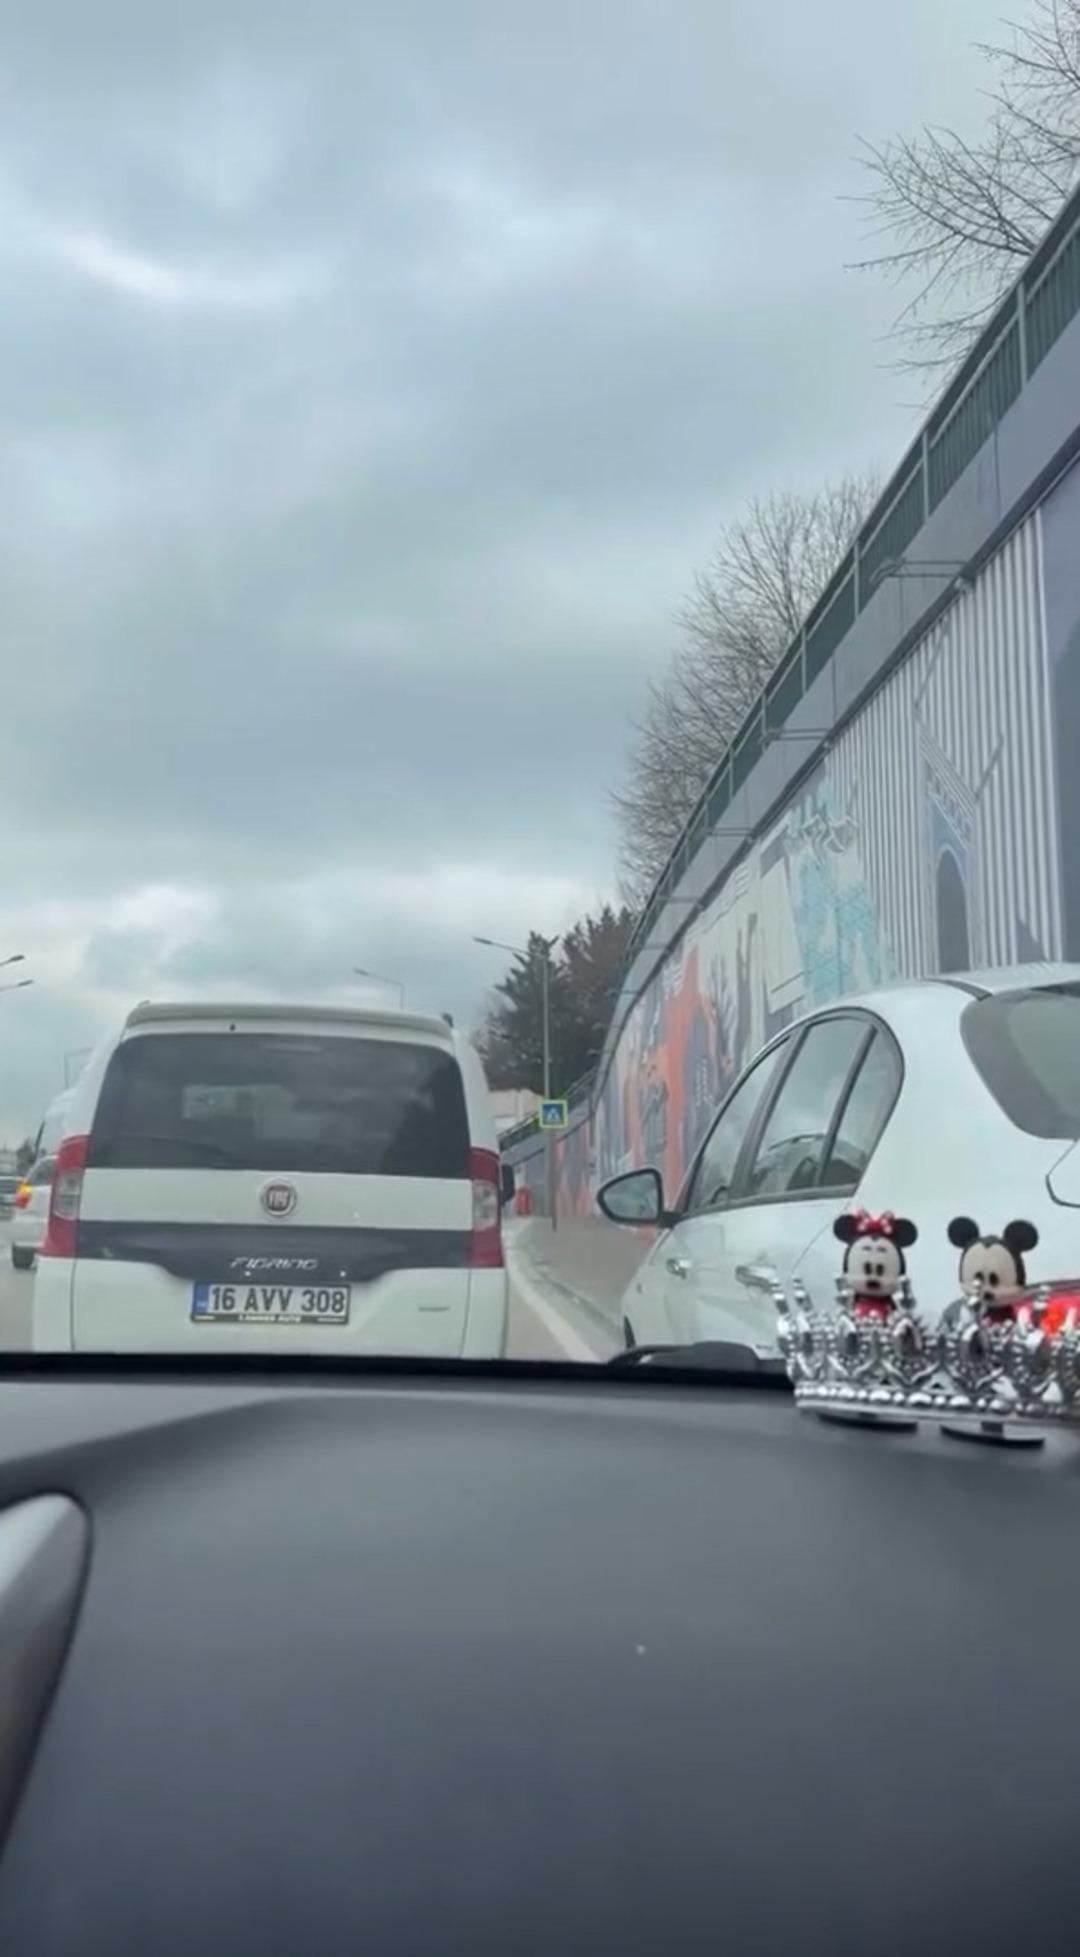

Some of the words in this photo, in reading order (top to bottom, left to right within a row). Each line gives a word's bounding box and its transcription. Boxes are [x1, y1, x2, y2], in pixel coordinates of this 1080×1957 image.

[212, 1286, 236, 1311] 16
[244, 1287, 293, 1312] AVV
[301, 1289, 345, 1313] 308
